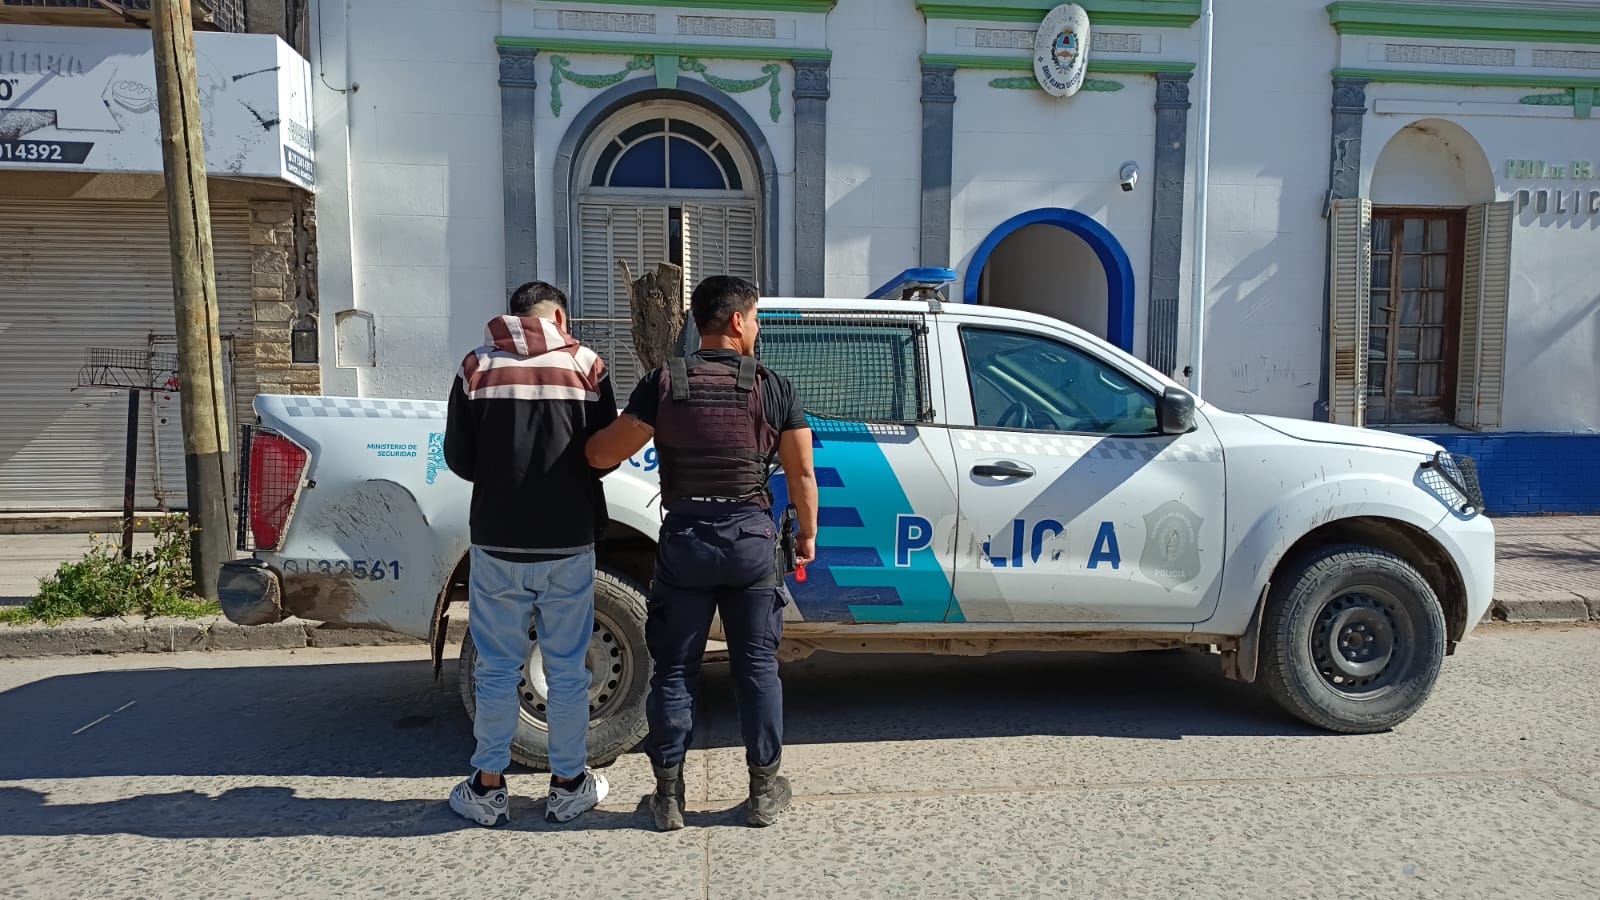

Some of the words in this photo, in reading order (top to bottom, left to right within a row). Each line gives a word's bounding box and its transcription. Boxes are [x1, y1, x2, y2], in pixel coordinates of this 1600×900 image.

[0, 143, 63, 160] 14392
[895, 513, 1122, 570] PLICA
[1154, 568, 1186, 578] POLICIA
